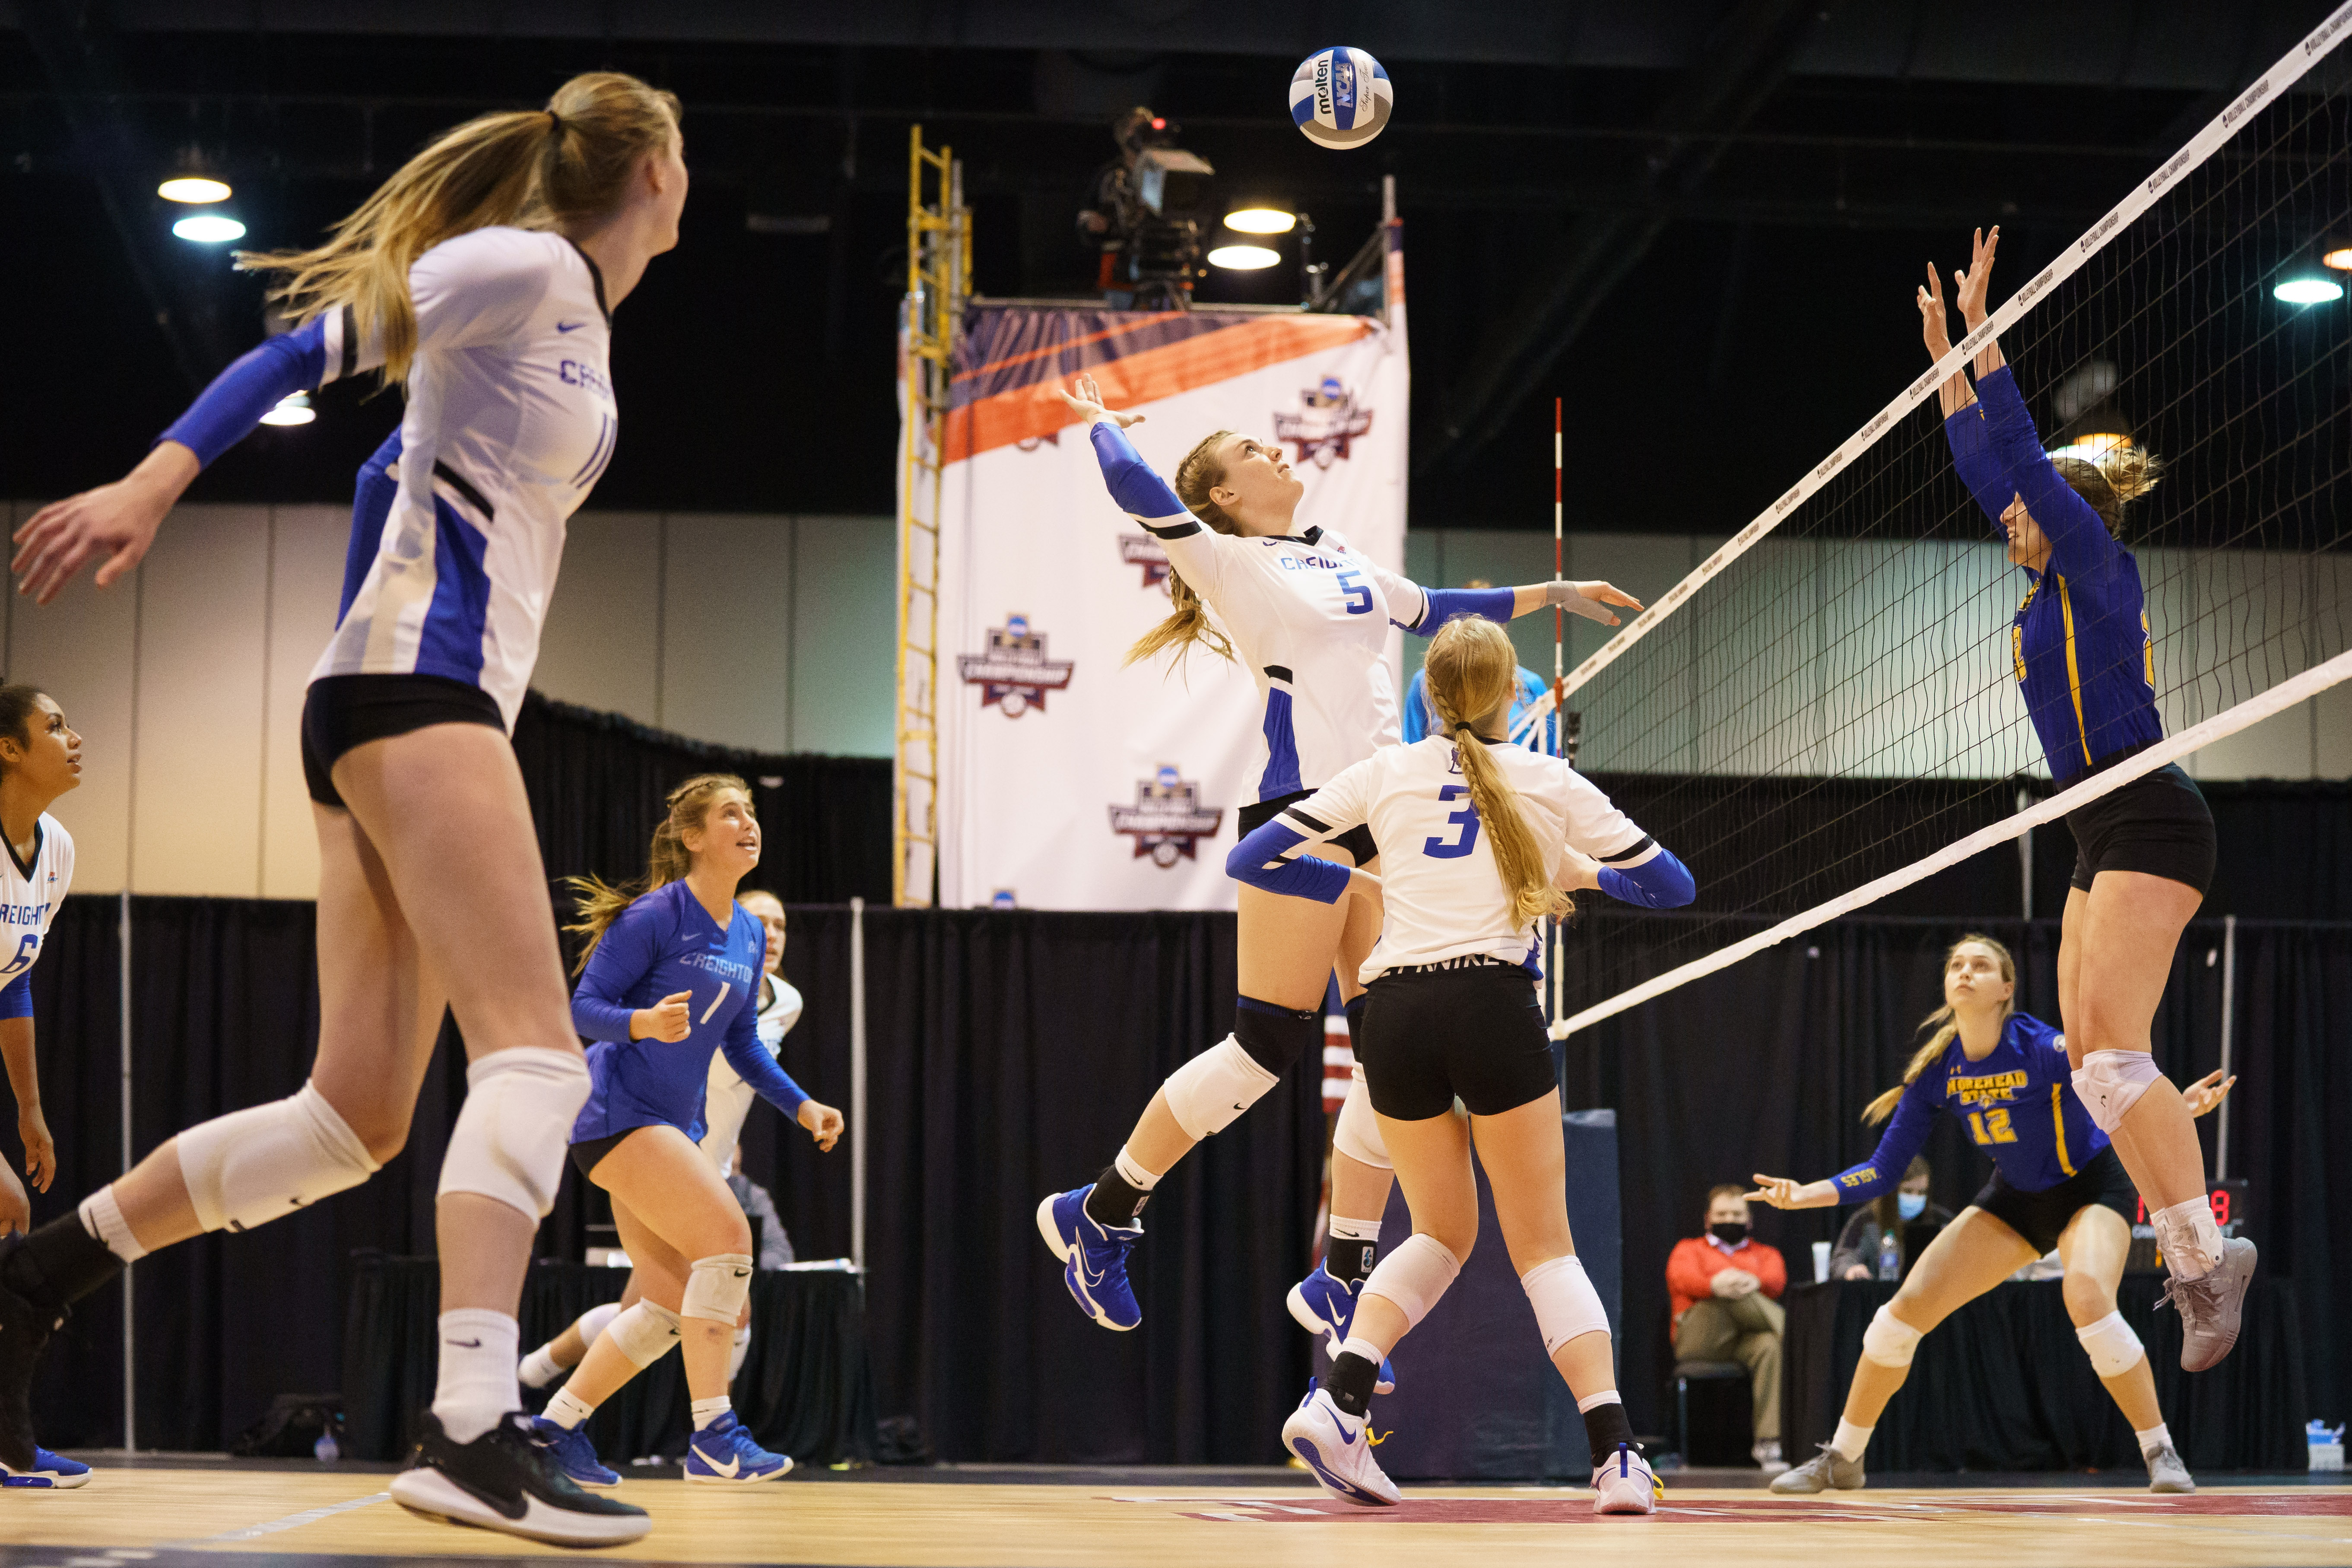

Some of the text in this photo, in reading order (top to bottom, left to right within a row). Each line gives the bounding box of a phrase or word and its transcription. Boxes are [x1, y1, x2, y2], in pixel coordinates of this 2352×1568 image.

[1315, 60, 1332, 114] molten
[1335, 63, 1351, 108] NCAA
[1359, 84, 1374, 112] Super
[1336, 570, 1373, 614] 5
[1422, 784, 1481, 859] 3
[0, 933, 38, 973] 6
[700, 981, 731, 1025] 1
[1946, 1070, 2028, 1098] MOREHEAD
[1968, 1108, 2018, 1145] 12
[2210, 1190, 2230, 1226] 8
